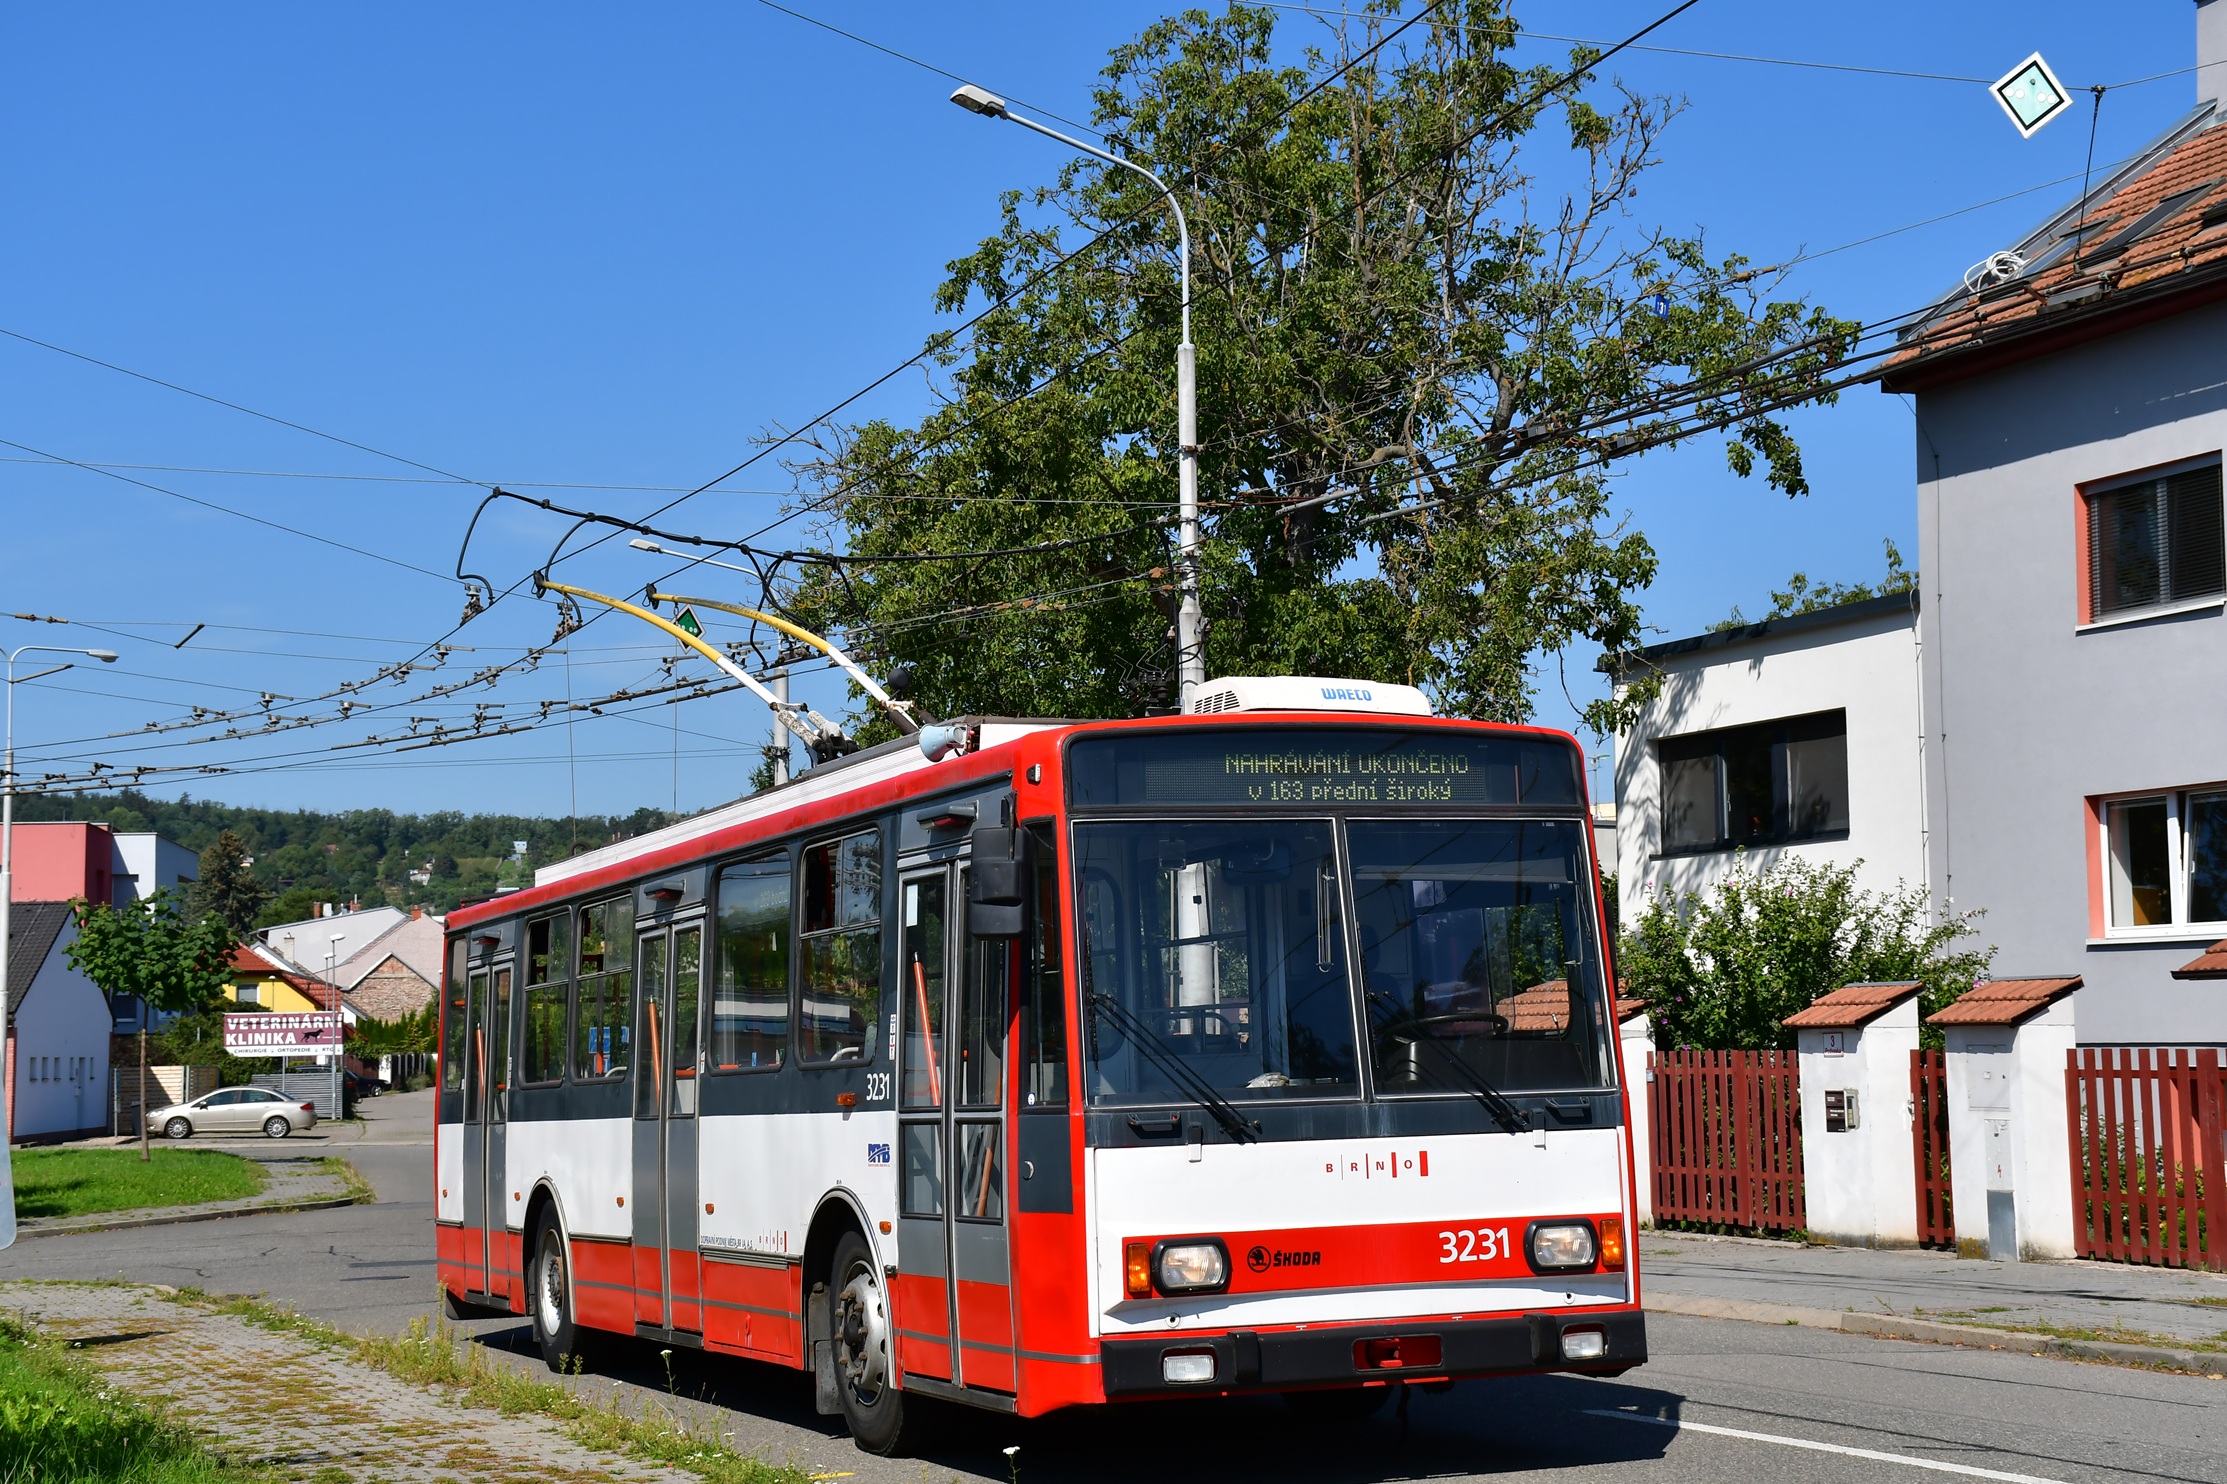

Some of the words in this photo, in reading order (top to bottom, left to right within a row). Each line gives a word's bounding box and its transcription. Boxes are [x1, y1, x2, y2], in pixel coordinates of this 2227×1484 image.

[1320, 687, 1372, 702] WAECO
[1225, 749, 1351, 774] NAHRÁVÁNÍ
[1358, 749, 1469, 774] UKONČENO
[1248, 787, 1262, 800] v
[1270, 780, 1304, 800] 163
[1311, 777, 1378, 800] přední
[1386, 777, 1452, 801] široký
[227, 1013, 343, 1030] VETERINÁRNÍ
[225, 1032, 296, 1045] KLINIKA
[1830, 1035, 1836, 1047] 3
[866, 1072, 890, 1101] 3231
[1438, 1227, 1511, 1264] 3231
[1272, 1249, 1321, 1267] ŠKODA
